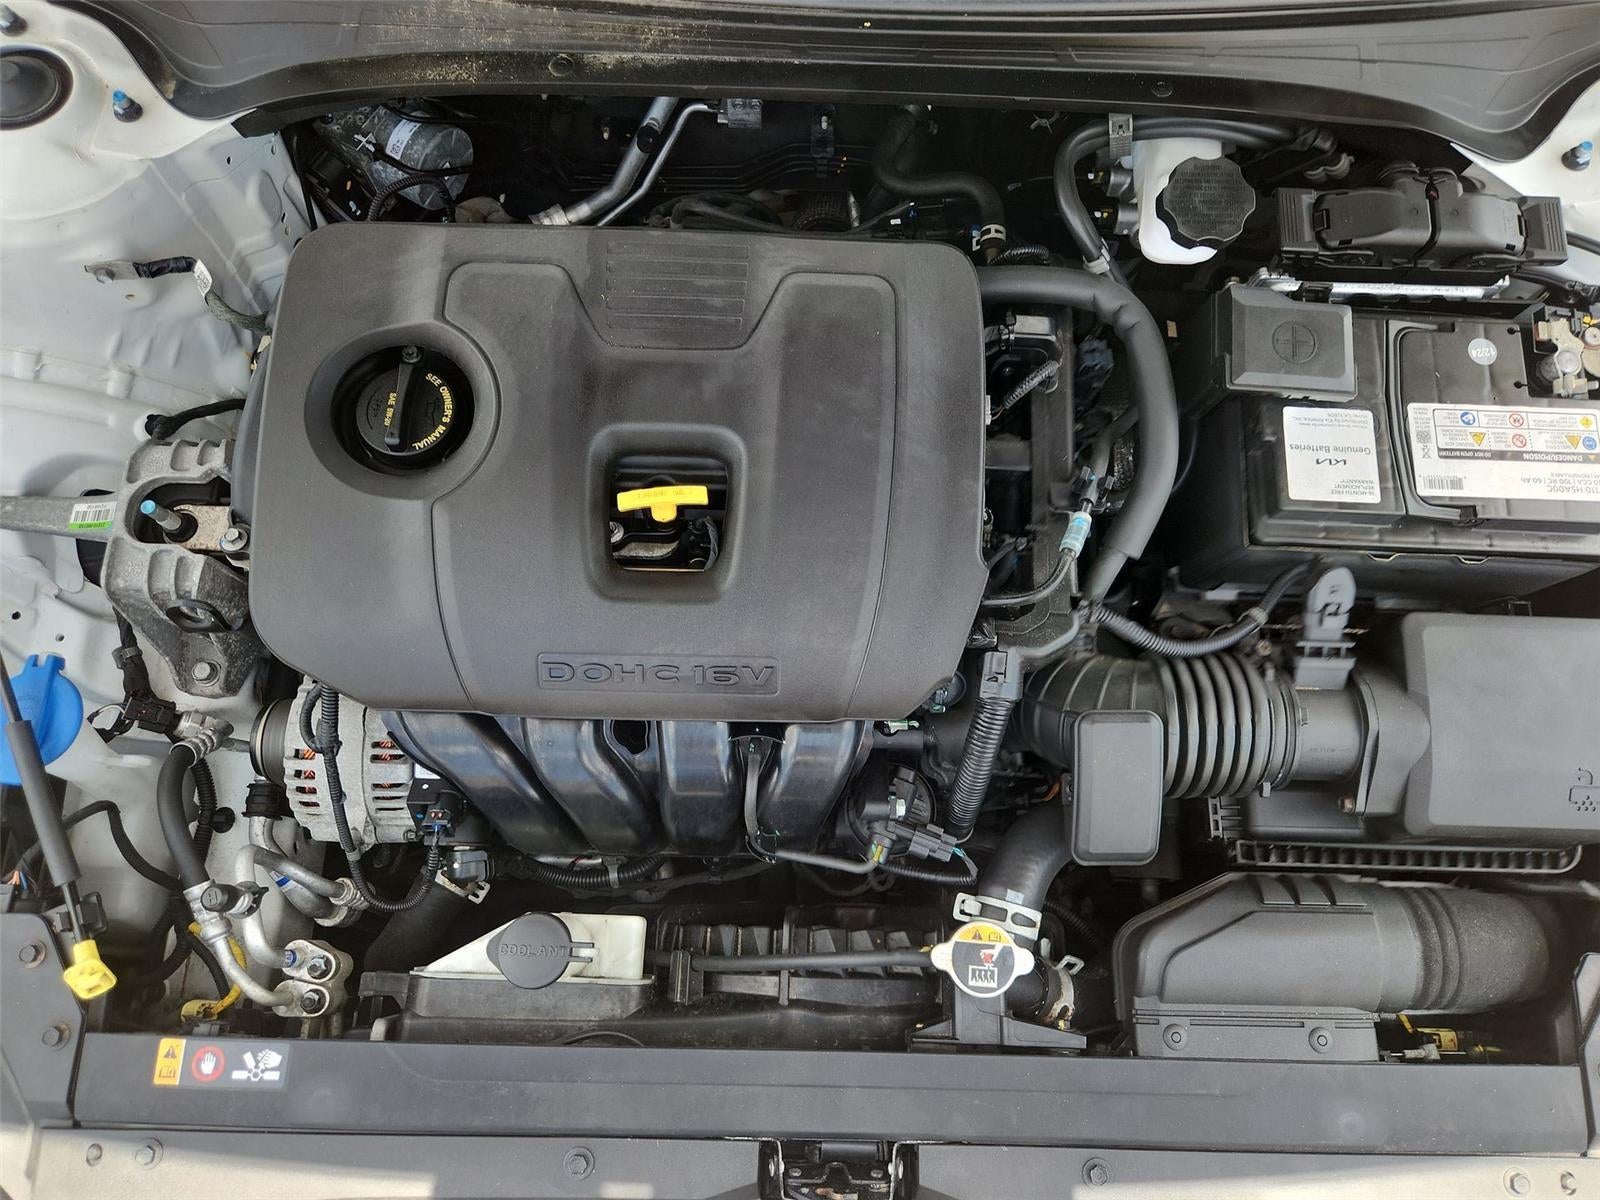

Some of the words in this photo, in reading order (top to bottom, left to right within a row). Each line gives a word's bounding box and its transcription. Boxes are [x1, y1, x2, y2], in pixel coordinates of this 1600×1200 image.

[425, 373, 441, 387] SEE
[387, 392, 397, 406] SAE
[439, 386, 453, 423] OWNER'S
[412, 425, 446, 450] MANUAL
[1289, 444, 1331, 454] Batteries
[1333, 446, 1371, 456] Genuine
[1316, 458, 1347, 466] KIA
[1523, 453, 1583, 462] DANGER/POISON
[541, 661, 680, 684] DOHC
[693, 664, 774, 687] 16V
[500, 943, 568, 957] COOLANT
